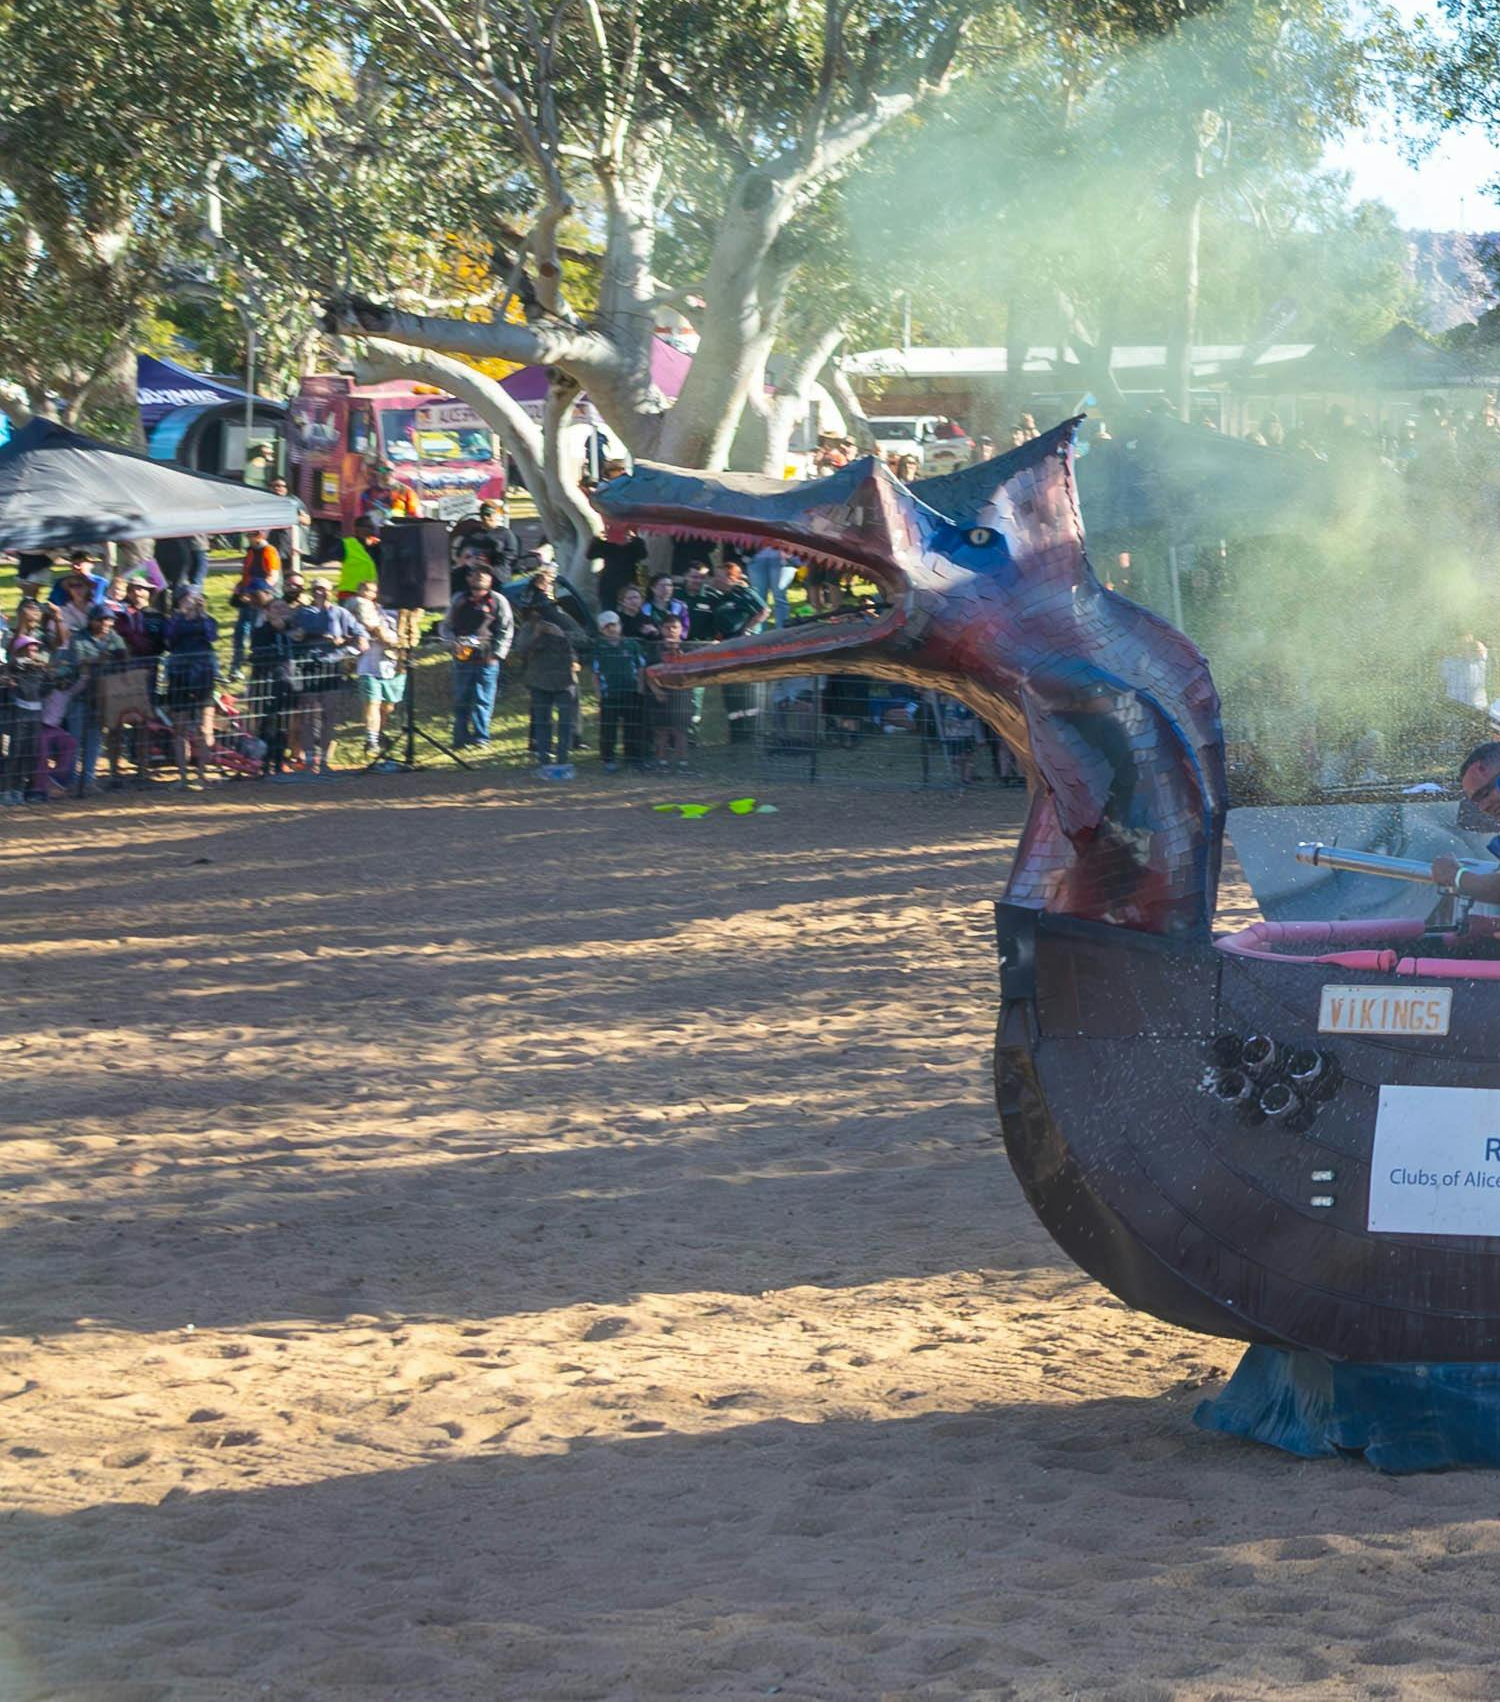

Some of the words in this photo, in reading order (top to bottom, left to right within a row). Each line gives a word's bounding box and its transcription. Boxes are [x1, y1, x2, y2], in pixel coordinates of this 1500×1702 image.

[1330, 999, 1442, 1032] VIKINGS
[1389, 1168, 1438, 1186] Clubs
[1442, 1168, 1460, 1187] of
